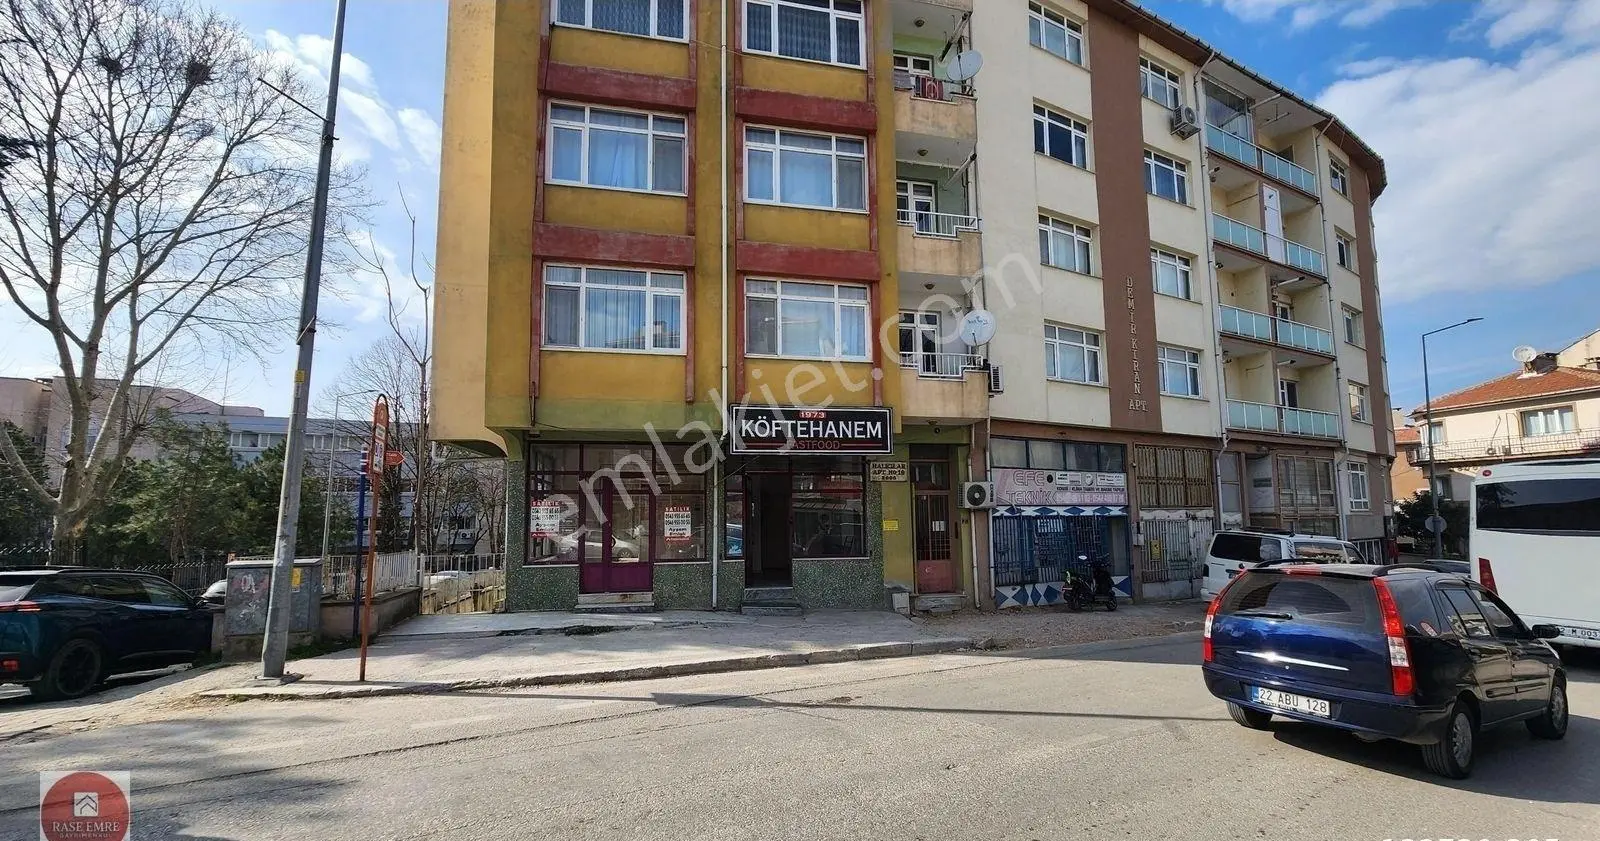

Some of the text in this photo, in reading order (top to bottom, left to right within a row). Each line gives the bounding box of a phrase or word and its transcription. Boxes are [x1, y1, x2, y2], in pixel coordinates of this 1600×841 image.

[800, 411, 826, 419] 1973
[741, 416, 882, 439] KÖFTEHANEM
[1013, 470, 1045, 486] EFE
[1260, 688, 1273, 701] 22
[1278, 693, 1299, 707] ABU
[1306, 698, 1327, 713] 128
